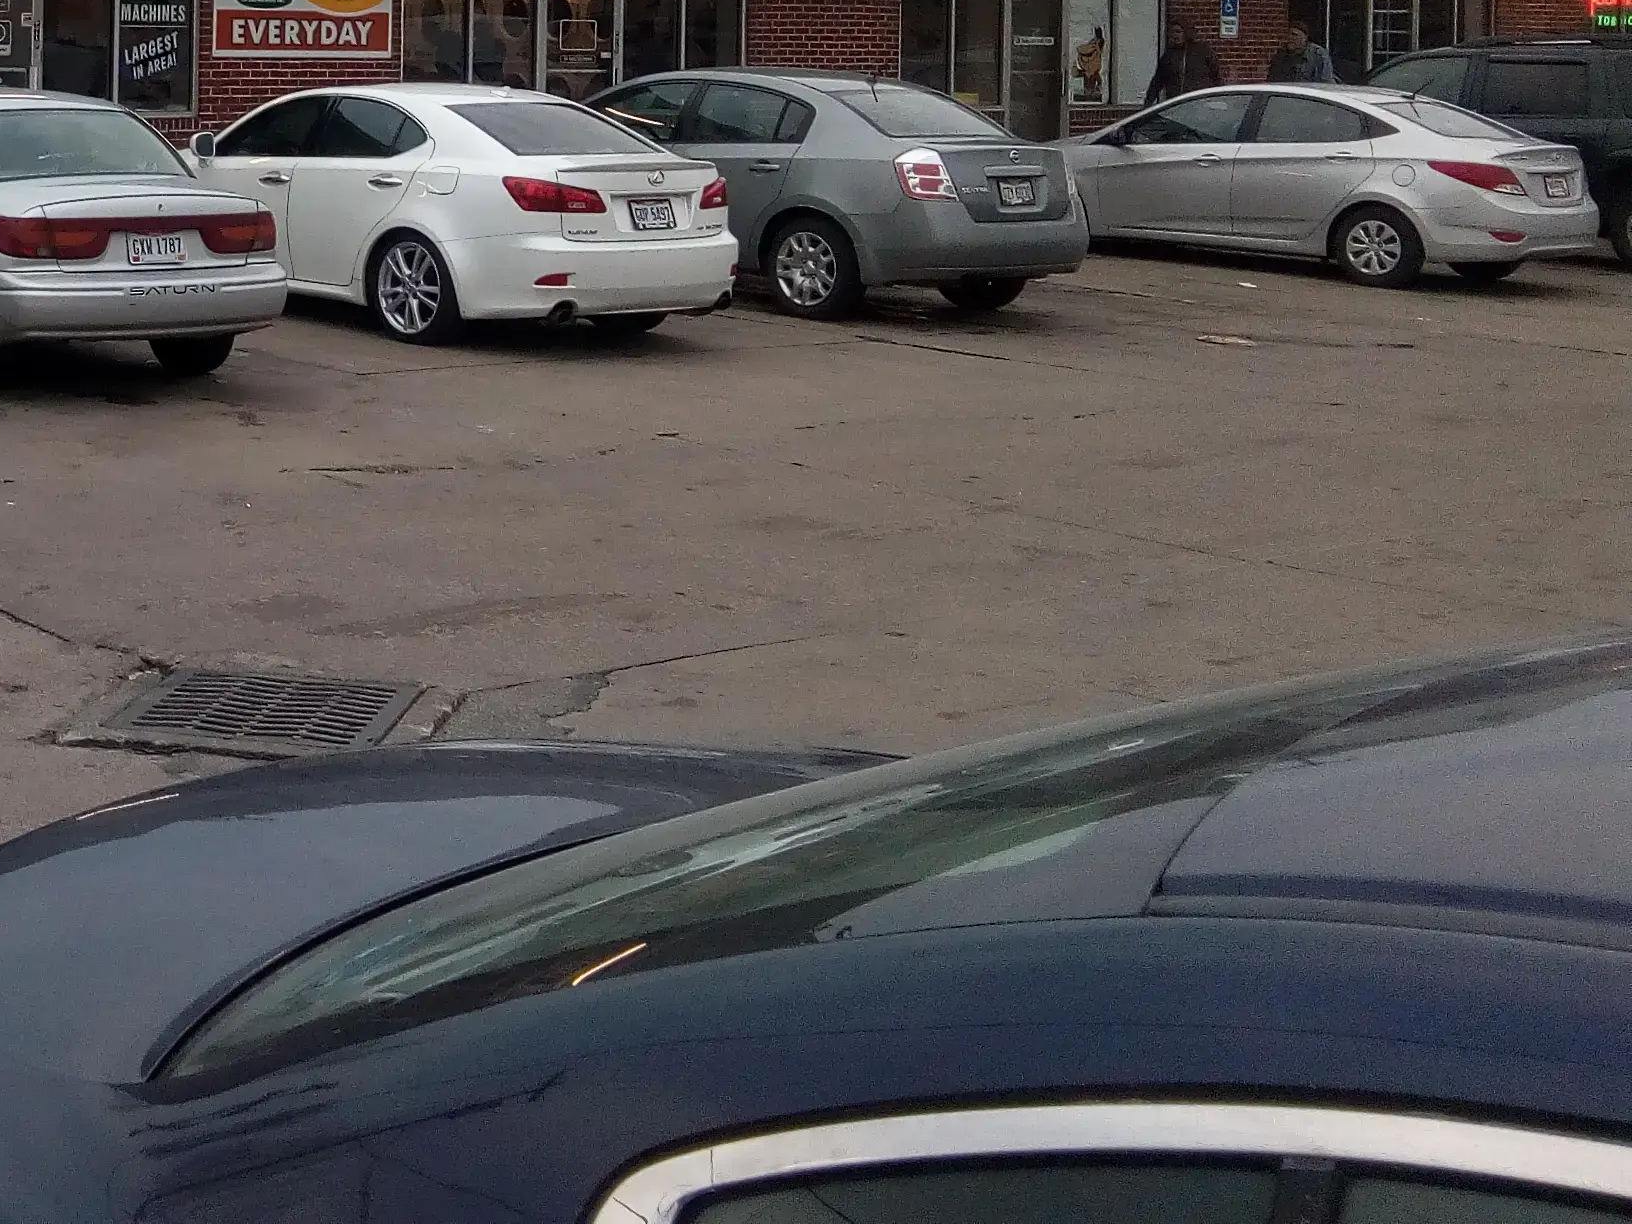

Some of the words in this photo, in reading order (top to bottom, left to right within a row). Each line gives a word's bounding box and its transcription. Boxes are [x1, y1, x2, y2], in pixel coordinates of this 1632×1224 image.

[121, 4, 186, 22] MACHINES
[231, 18, 373, 46] EVERYDAY
[125, 31, 179, 66] LARGEST
[133, 64, 144, 80] IN
[147, 52, 177, 76] AREA!
[129, 285, 216, 295] SATURN
